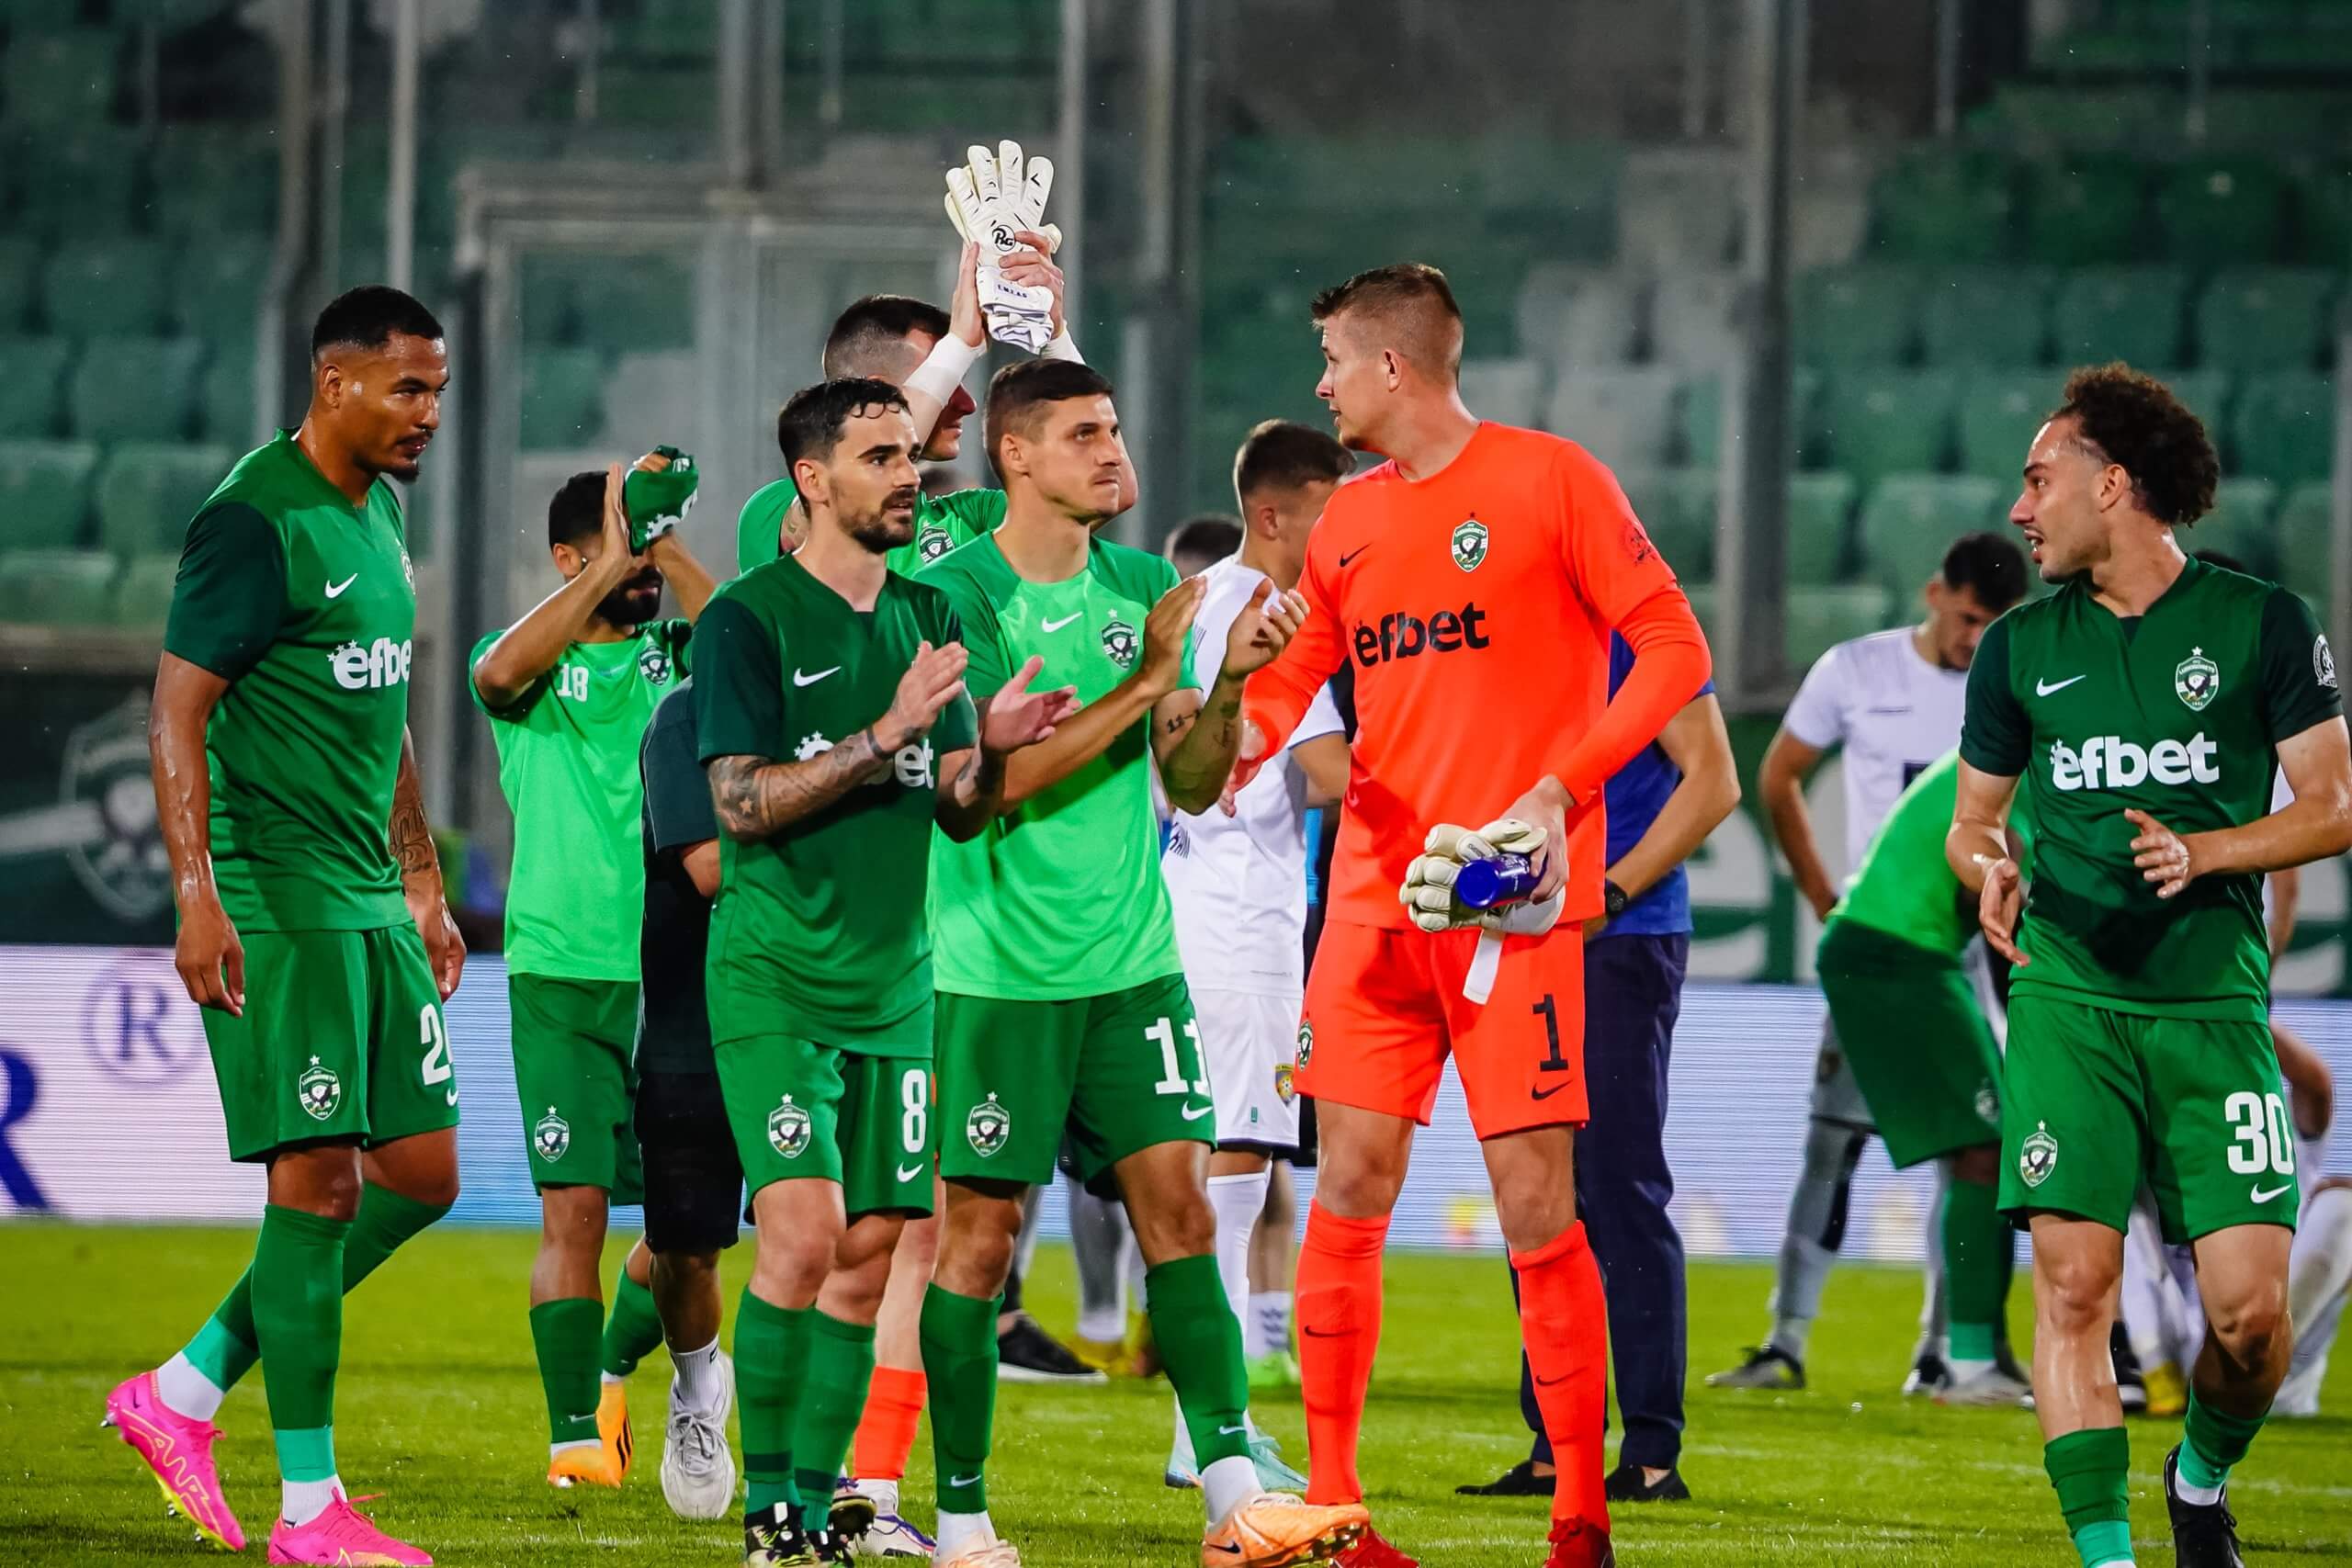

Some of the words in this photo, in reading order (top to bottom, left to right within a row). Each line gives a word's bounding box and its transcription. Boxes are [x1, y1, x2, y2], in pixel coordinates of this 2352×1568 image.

[1354, 602, 1490, 667] efbet
[557, 662, 590, 703] 18
[2050, 731, 2221, 791] efbet
[1145, 1017, 1213, 1097] 11
[1532, 994, 1569, 1072] 1
[902, 1068, 927, 1153] 8
[2224, 1091, 2294, 1176] 30
